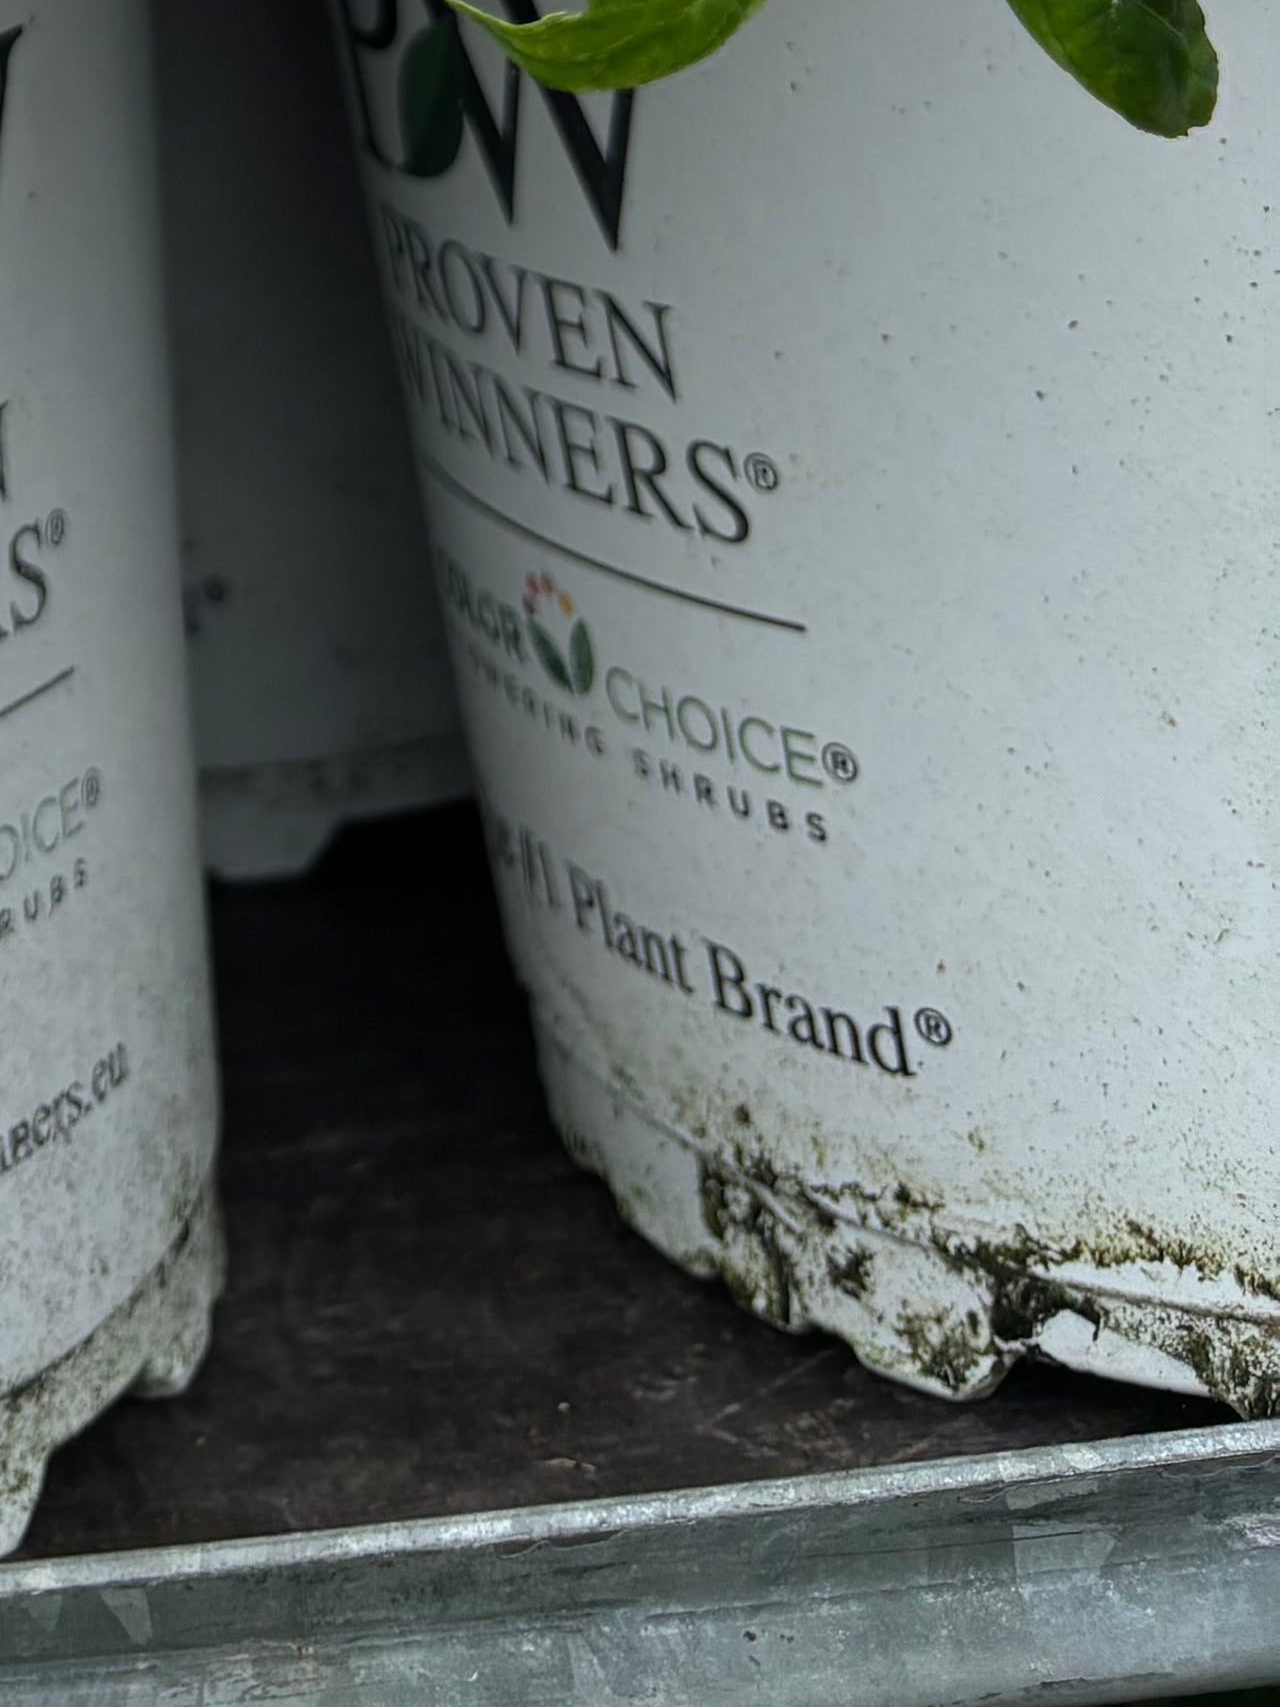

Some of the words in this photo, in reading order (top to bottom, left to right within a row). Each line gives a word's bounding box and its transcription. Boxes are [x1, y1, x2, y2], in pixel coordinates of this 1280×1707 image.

[380, 201, 680, 405] PROVEN
[632, 747, 829, 844] SHRUBS
[566, 858, 696, 997] Plant
